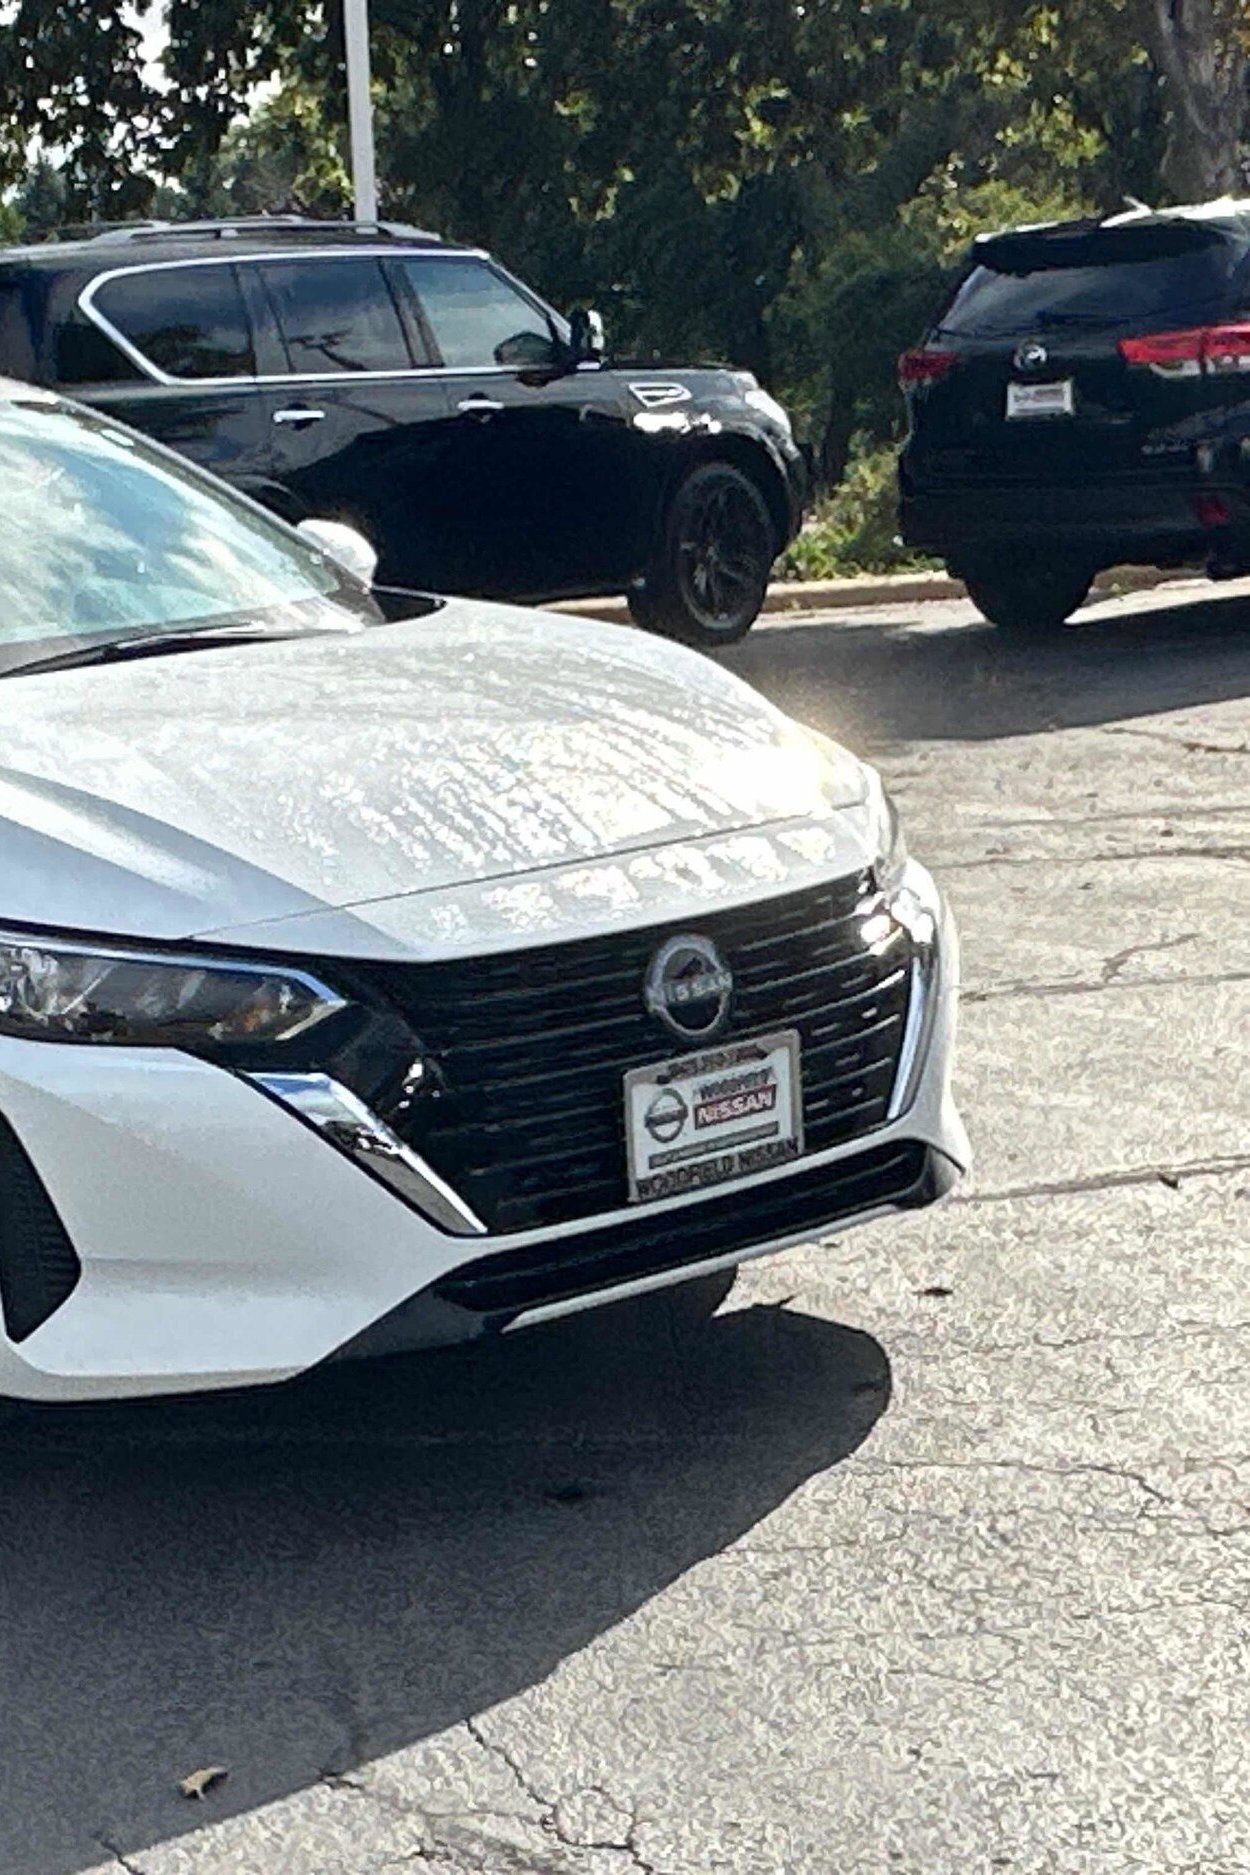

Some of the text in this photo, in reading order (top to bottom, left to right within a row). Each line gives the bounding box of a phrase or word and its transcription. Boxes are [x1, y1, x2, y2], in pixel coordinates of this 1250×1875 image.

[697, 1091, 772, 1123] NISSAN
[637, 1155, 735, 1200] WOODFIELD
[738, 1137, 799, 1171] NISSAN
